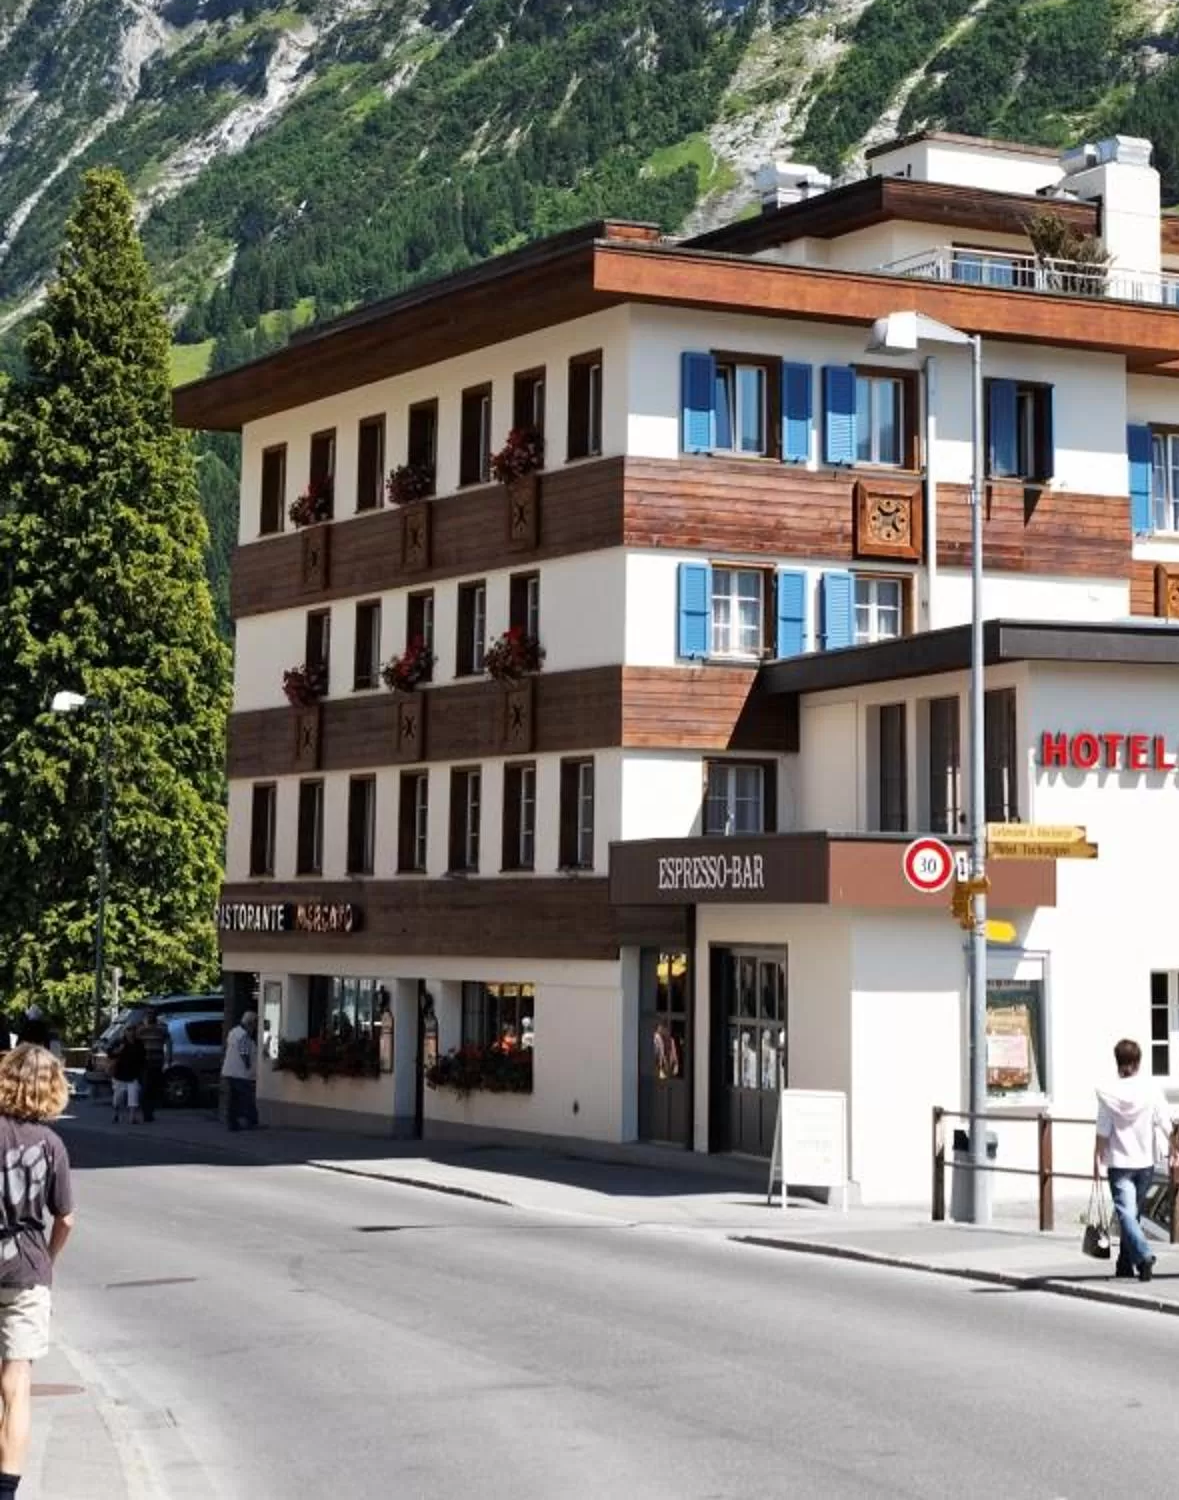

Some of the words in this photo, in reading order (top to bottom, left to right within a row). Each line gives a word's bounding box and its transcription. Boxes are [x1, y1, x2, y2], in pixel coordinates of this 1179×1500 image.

[1041, 731, 1175, 771] HOTEL
[658, 854, 765, 889] ESPRESSO-BAR
[919, 857, 937, 873] 30
